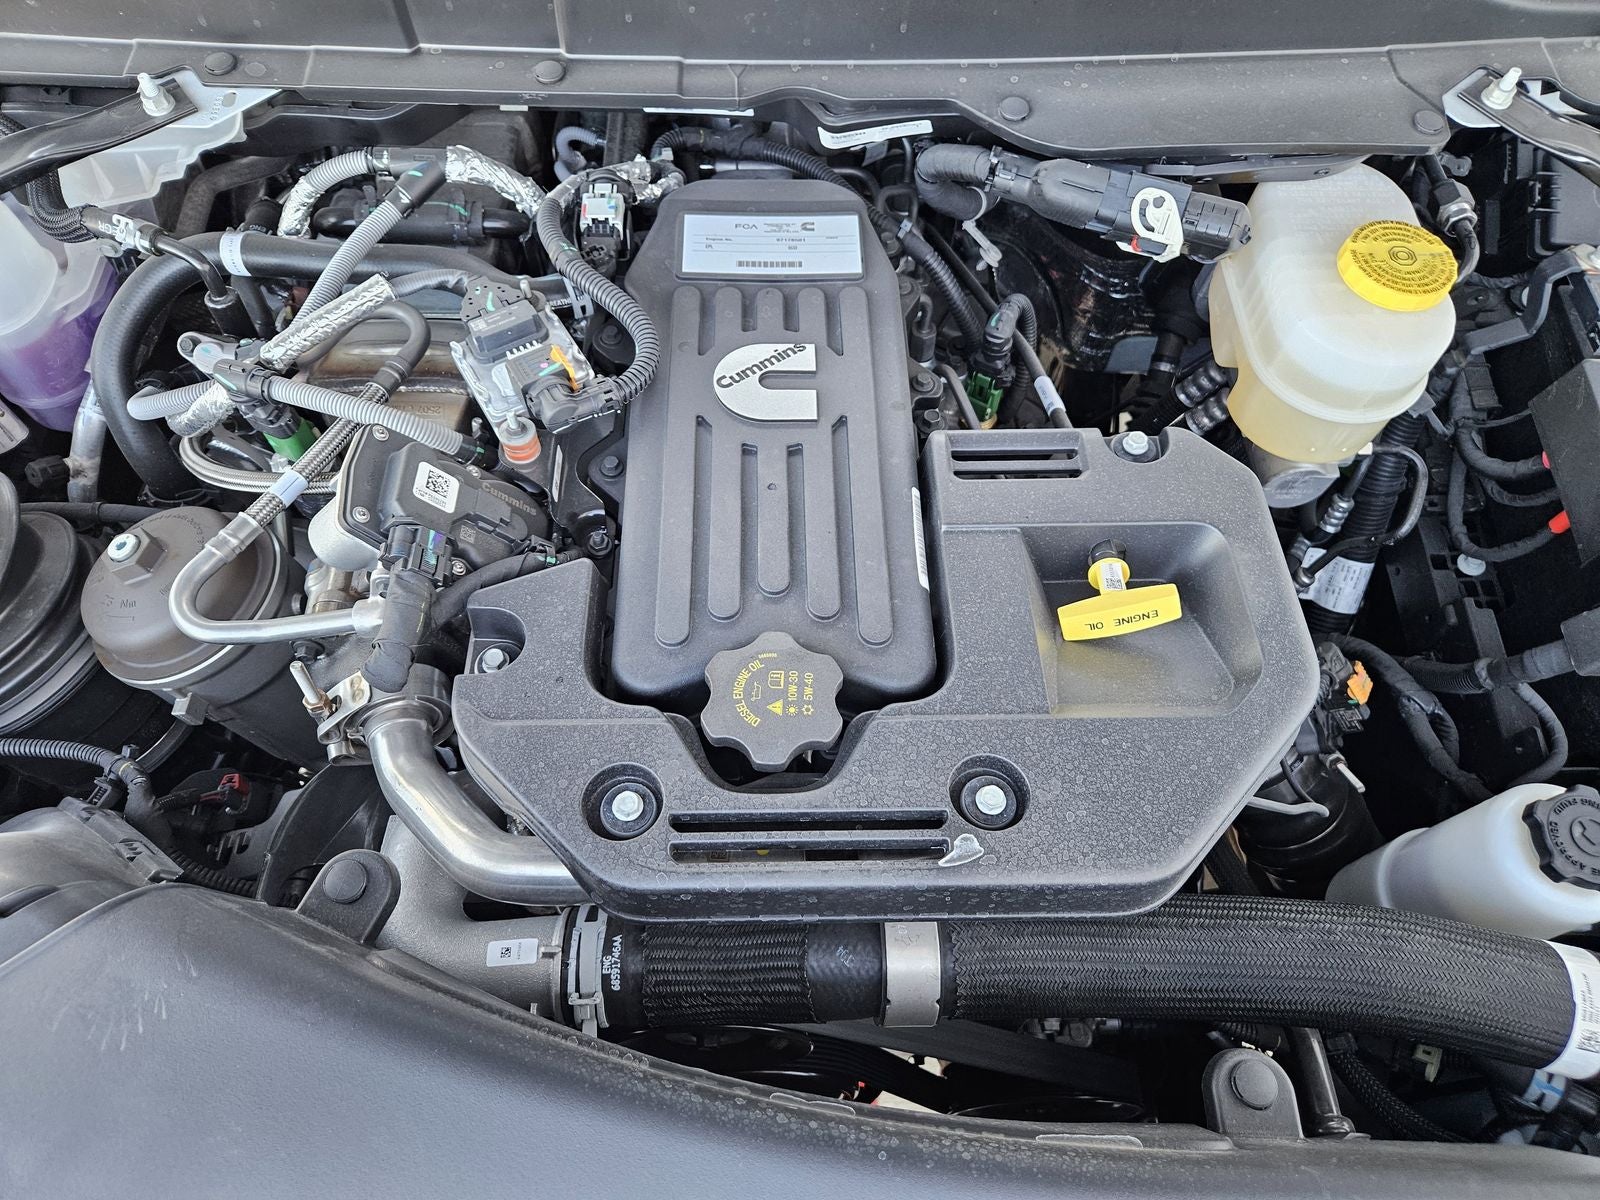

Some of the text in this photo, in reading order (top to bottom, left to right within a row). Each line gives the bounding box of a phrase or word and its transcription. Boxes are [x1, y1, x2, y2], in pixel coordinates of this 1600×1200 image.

[716, 343, 807, 389] Cummins
[481, 482, 537, 516] Cummins
[1084, 609, 1159, 631] ENGINE OIL
[733, 660, 765, 727] DIESEL ENGINE OIL
[787, 670, 799, 702] 10W-30
[803, 672, 814, 701] 5W-40
[602, 955, 612, 974] ENG
[610, 934, 623, 991] 68591746AA
